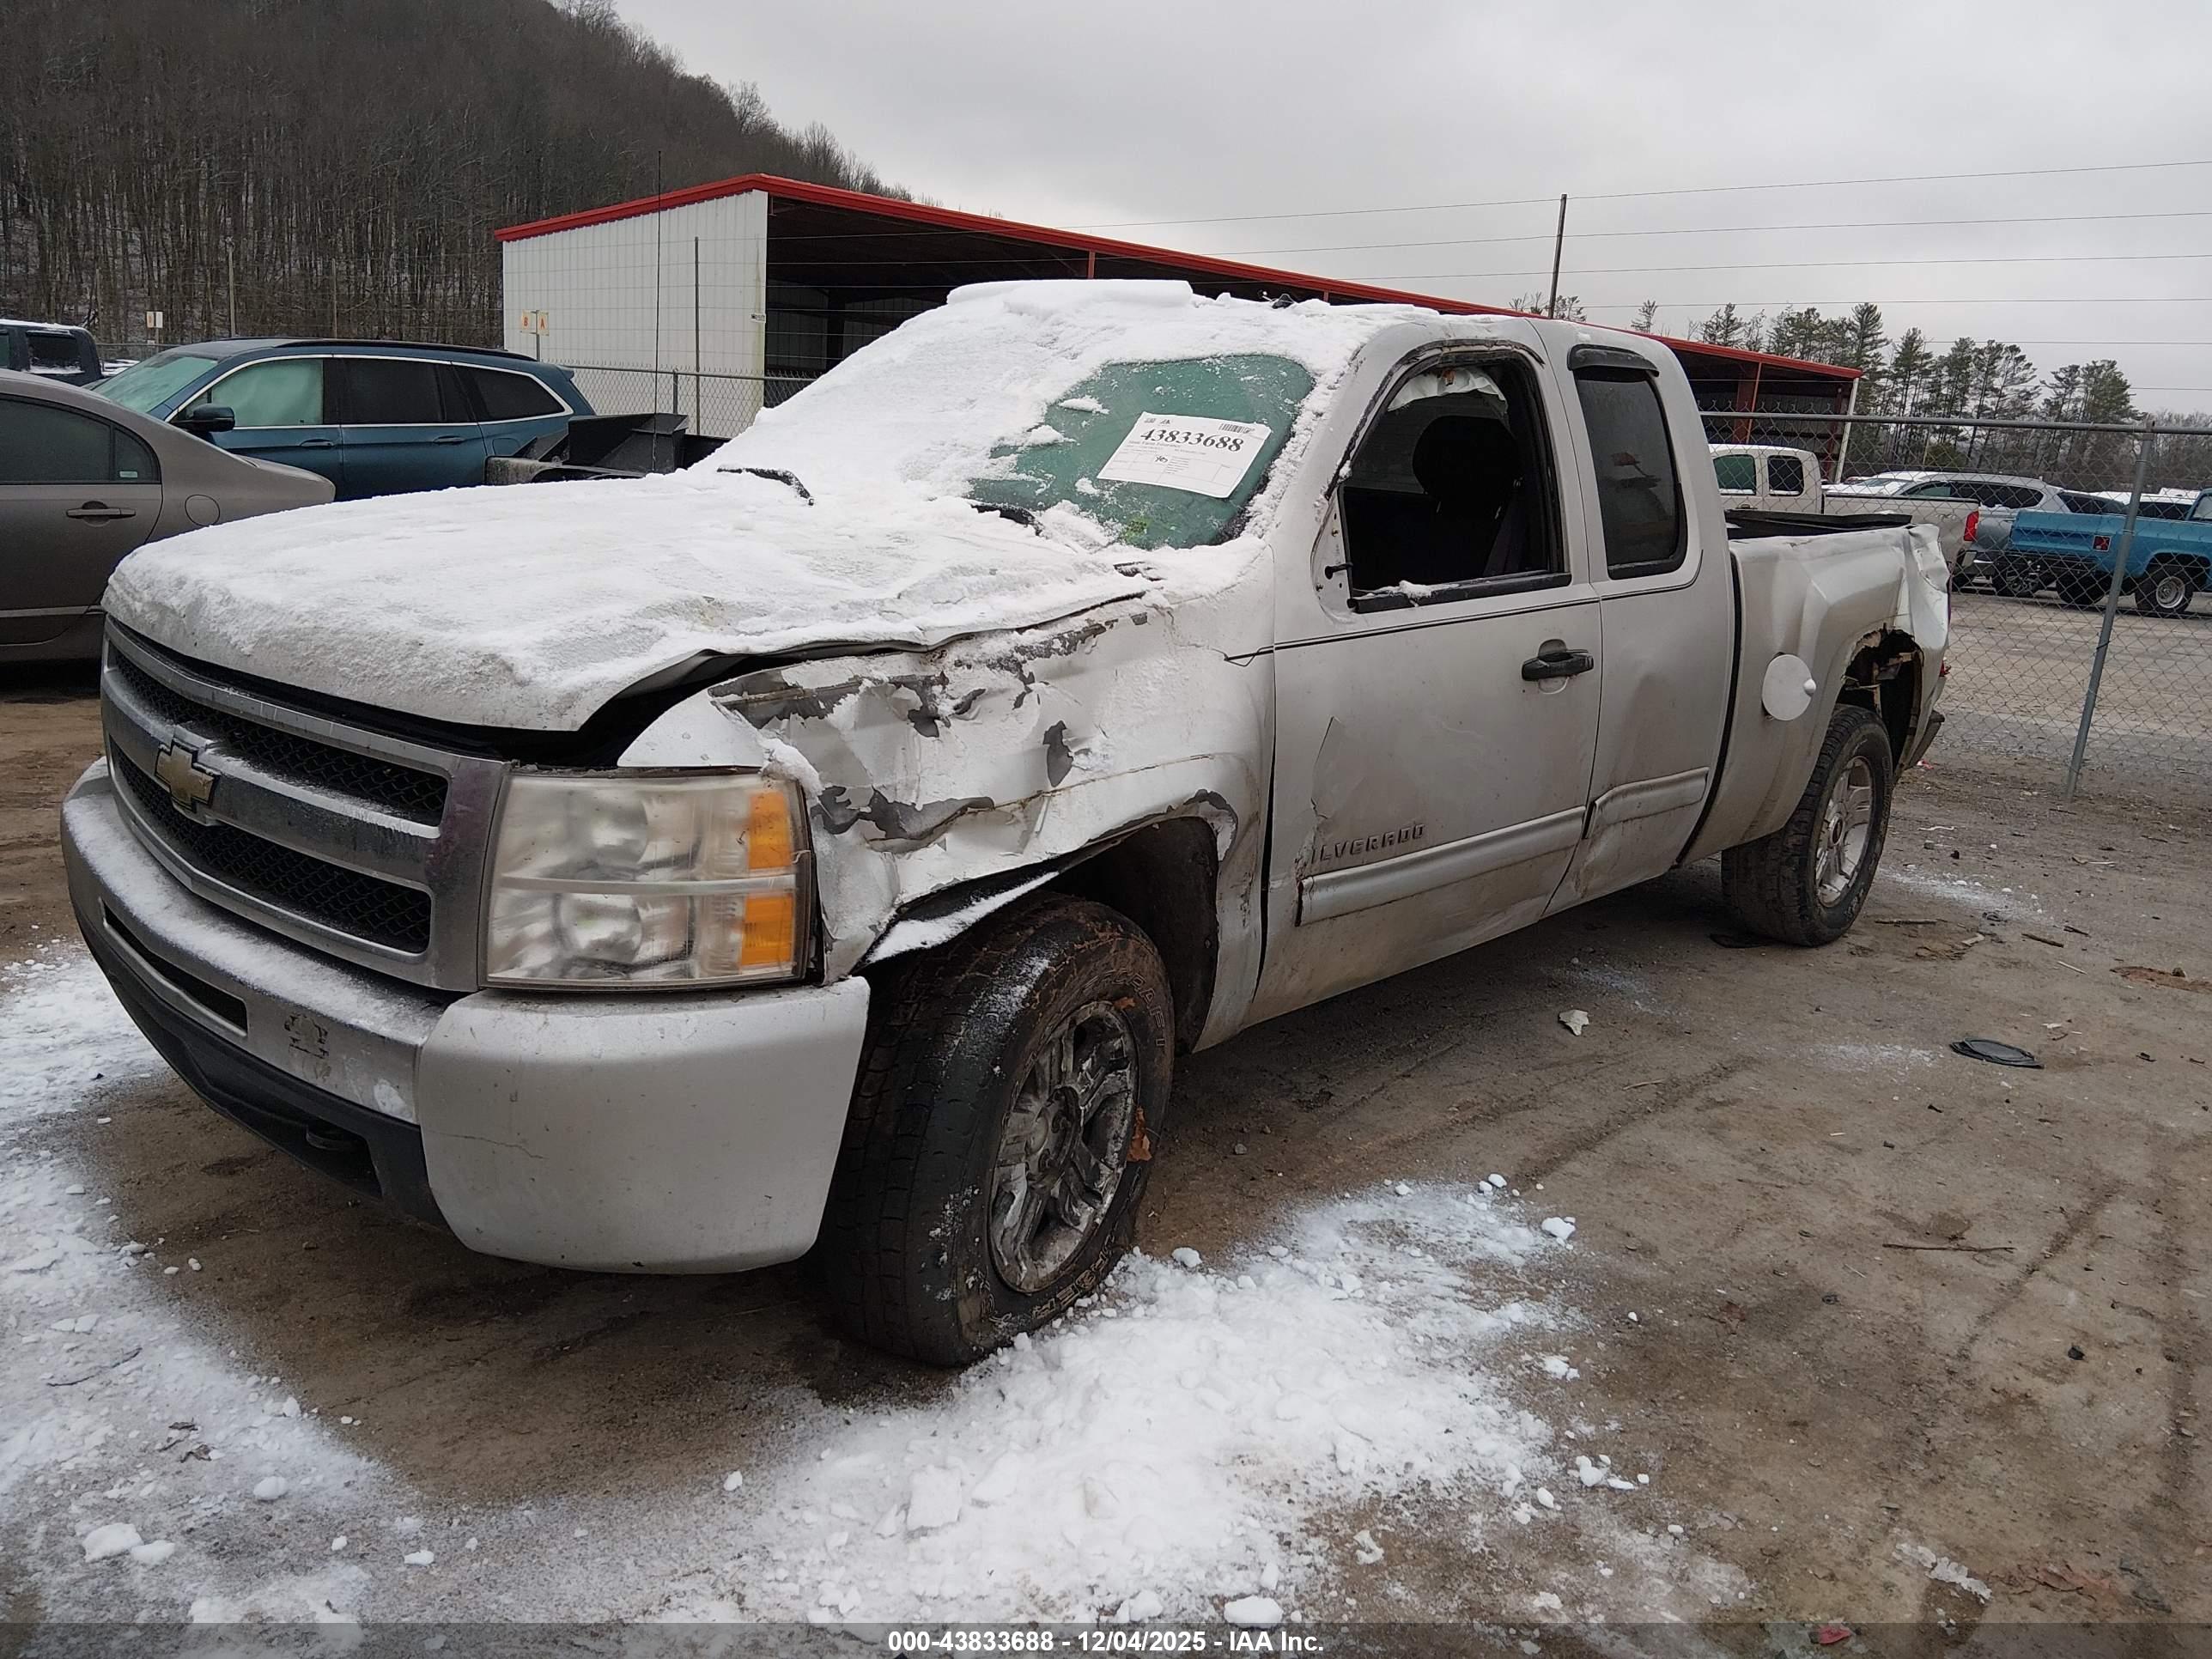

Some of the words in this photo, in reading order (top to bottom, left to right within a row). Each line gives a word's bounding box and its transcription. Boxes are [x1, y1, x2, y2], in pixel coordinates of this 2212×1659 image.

[540, 318, 545, 329] A
[1140, 428, 1244, 452] 43833688
[1310, 822, 1425, 865] ILVERADO
